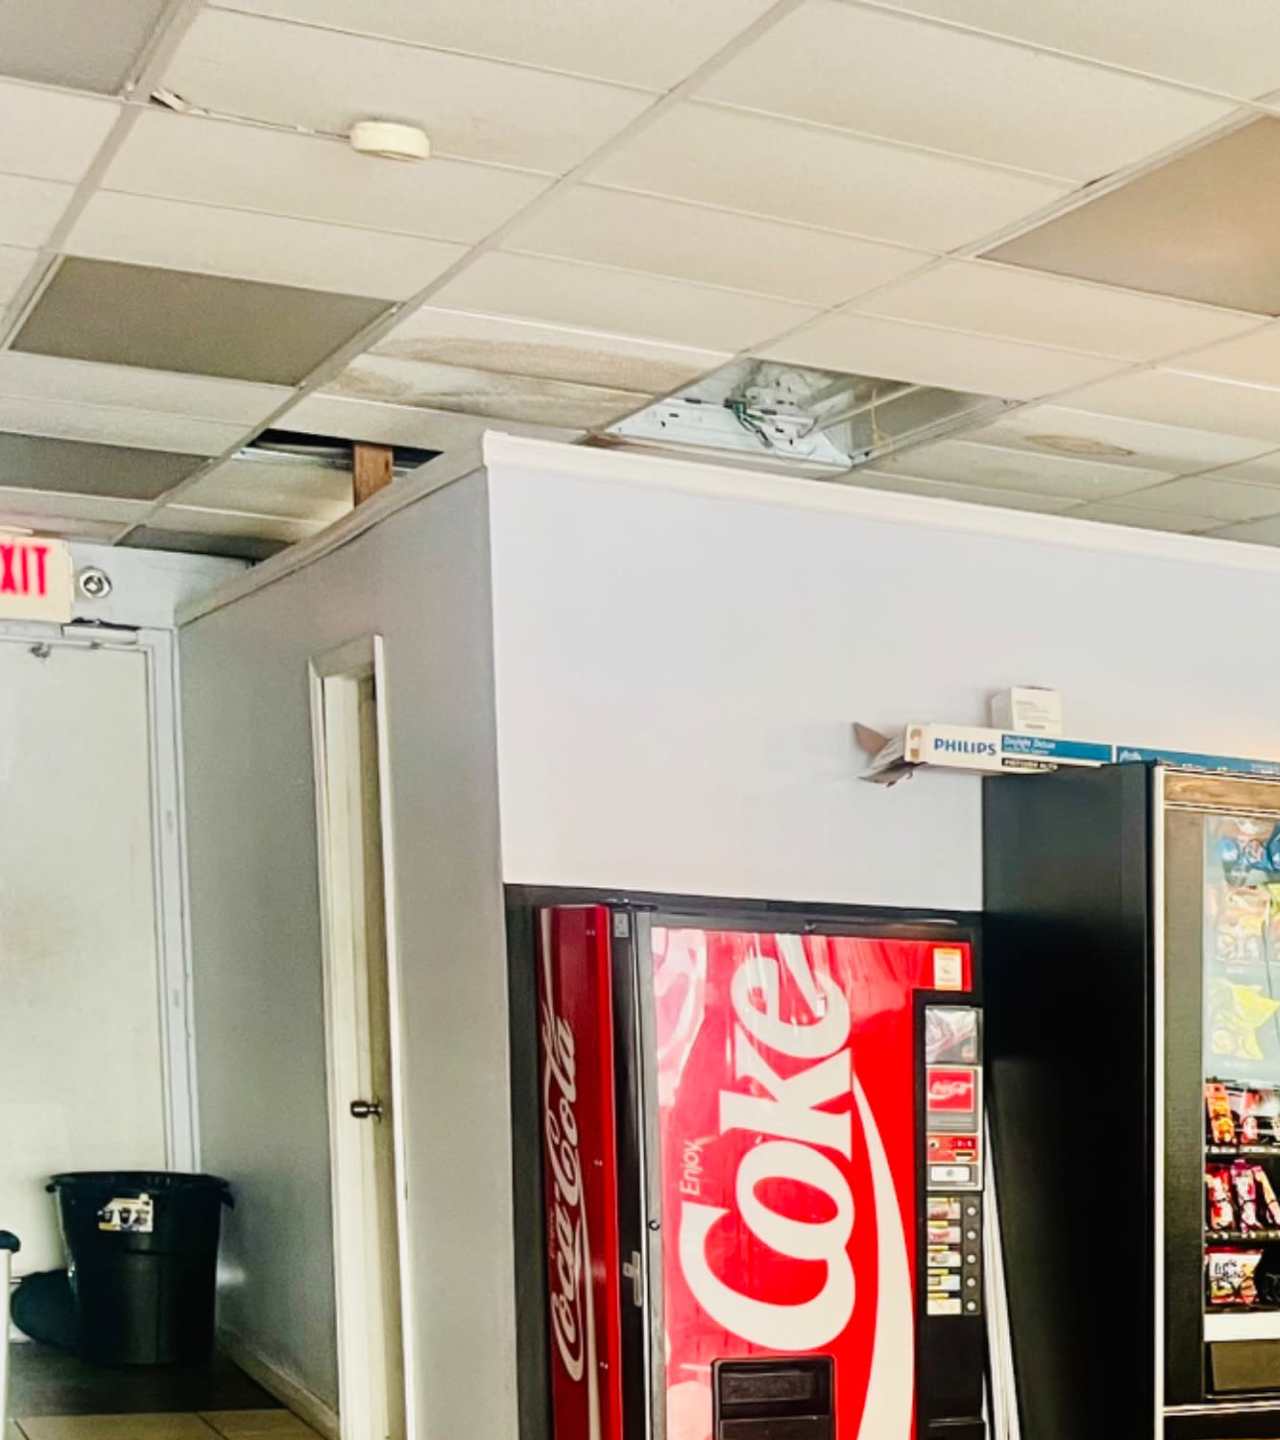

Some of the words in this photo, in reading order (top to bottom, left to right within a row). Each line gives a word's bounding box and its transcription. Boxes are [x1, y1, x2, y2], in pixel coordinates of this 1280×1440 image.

[0, 544, 48, 595] XIT
[934, 738, 997, 756] PHILIPS
[680, 932, 857, 1351] Coke
[680, 1135, 719, 1197] Enjoy
